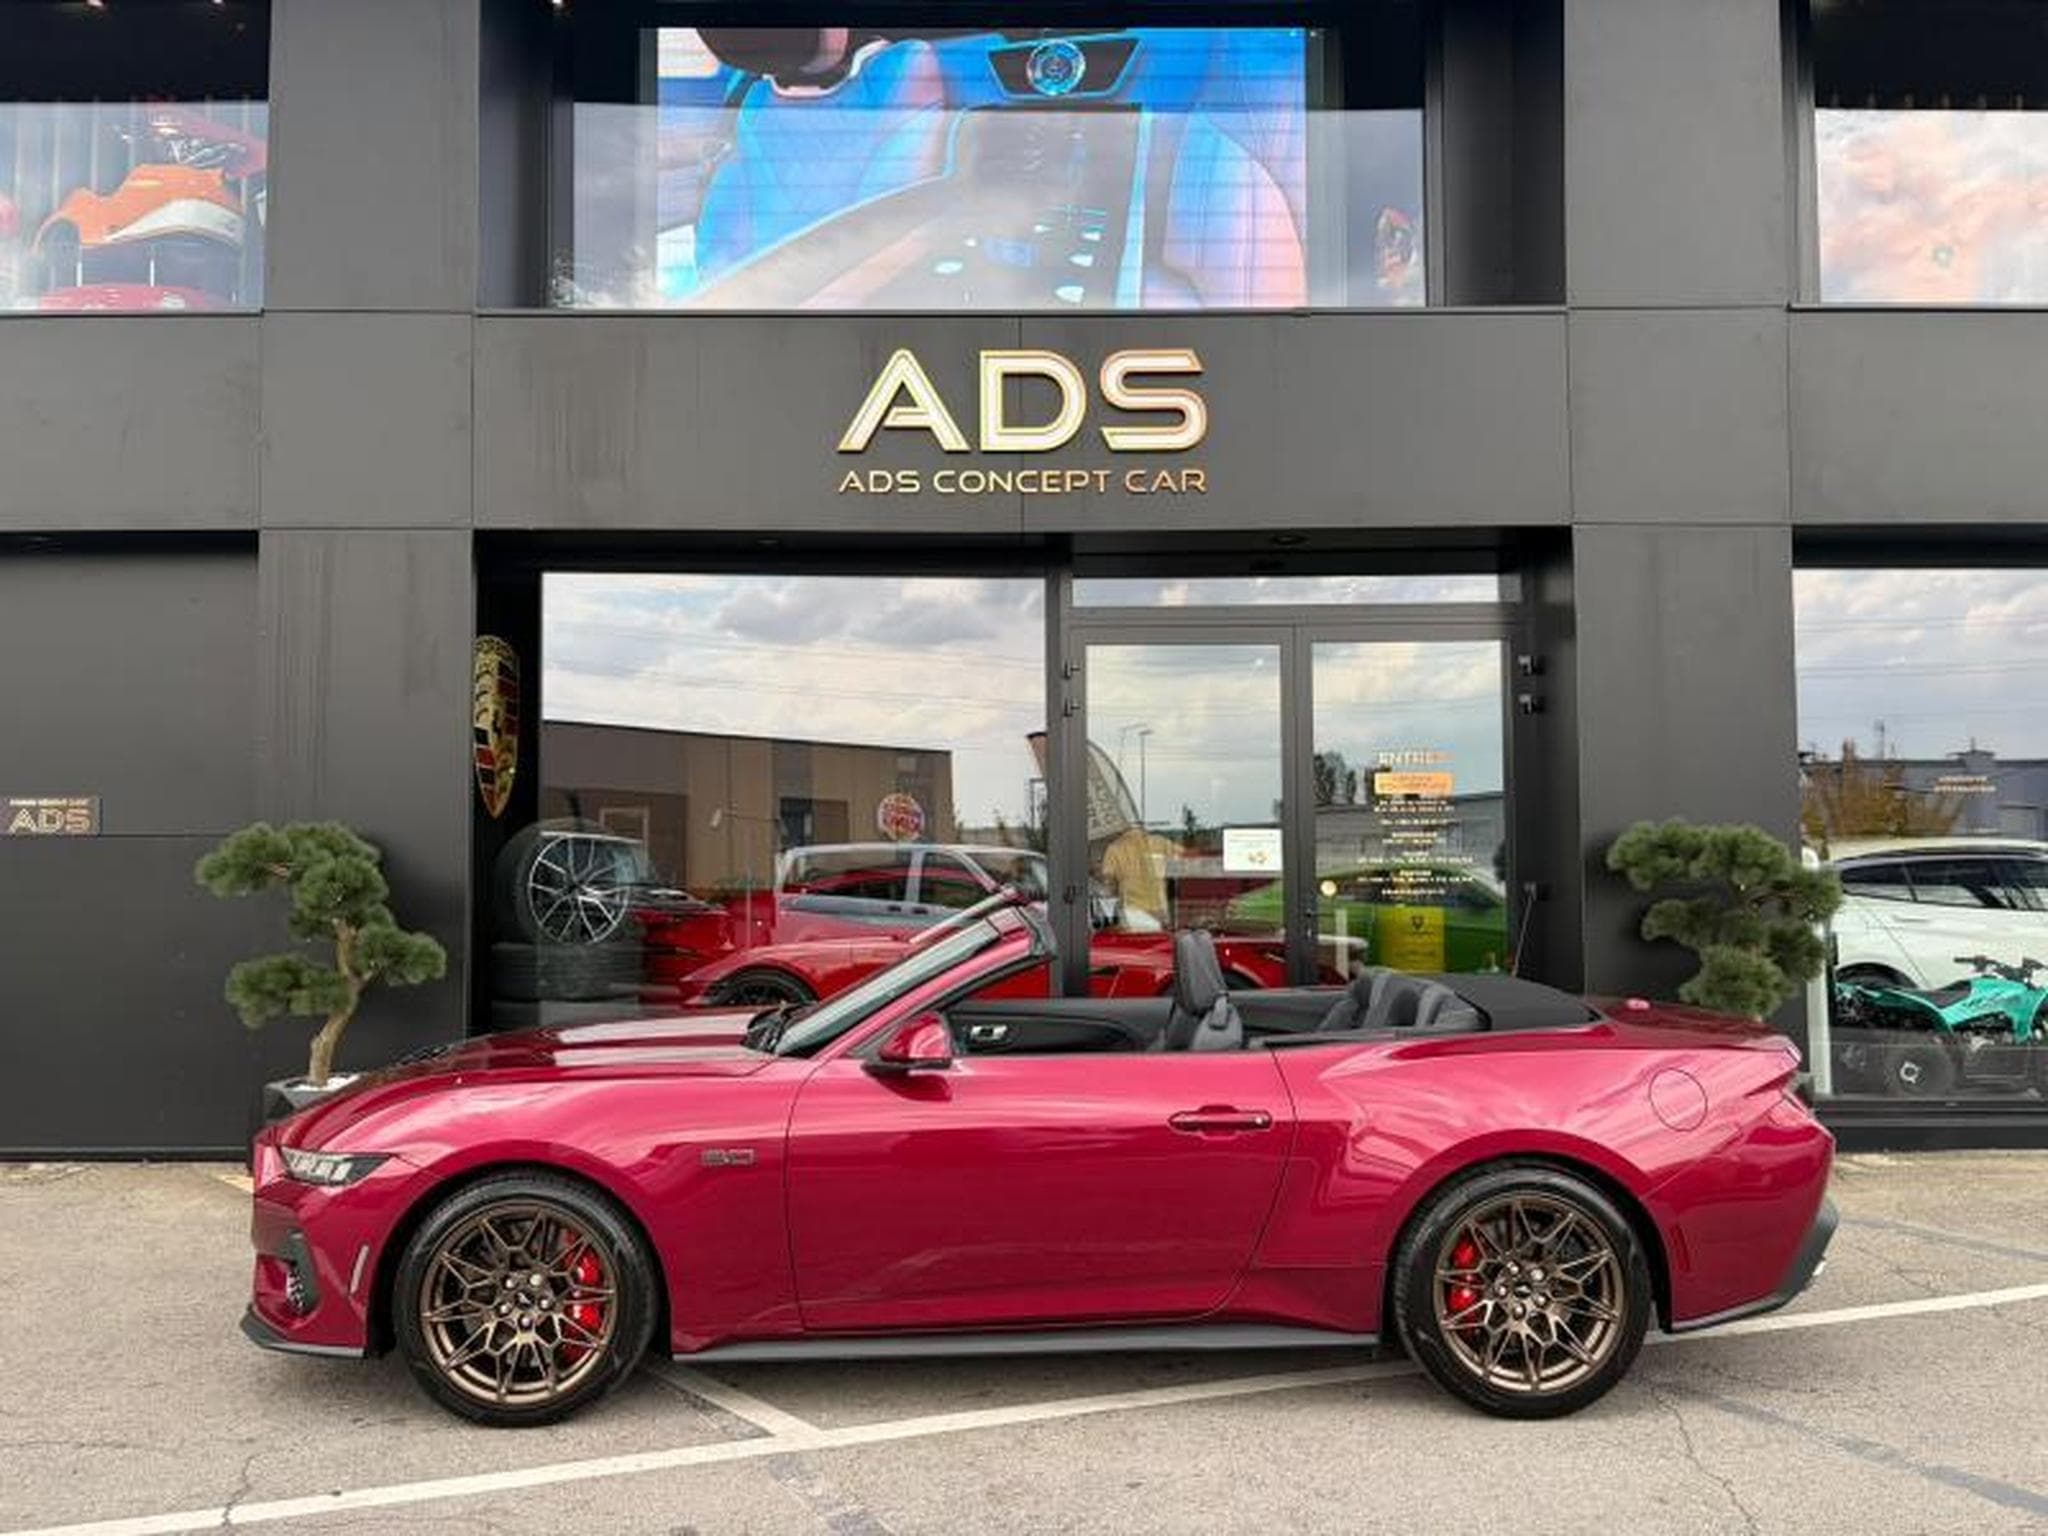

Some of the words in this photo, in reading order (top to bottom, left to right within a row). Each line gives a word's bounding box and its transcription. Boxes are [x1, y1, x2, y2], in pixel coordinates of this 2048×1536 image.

[837, 348, 1208, 453] ADS
[838, 470, 919, 493] ADS
[933, 469, 1112, 494] CONCEPT
[1124, 469, 1207, 494] CAR
[8, 807, 91, 833] ADS
